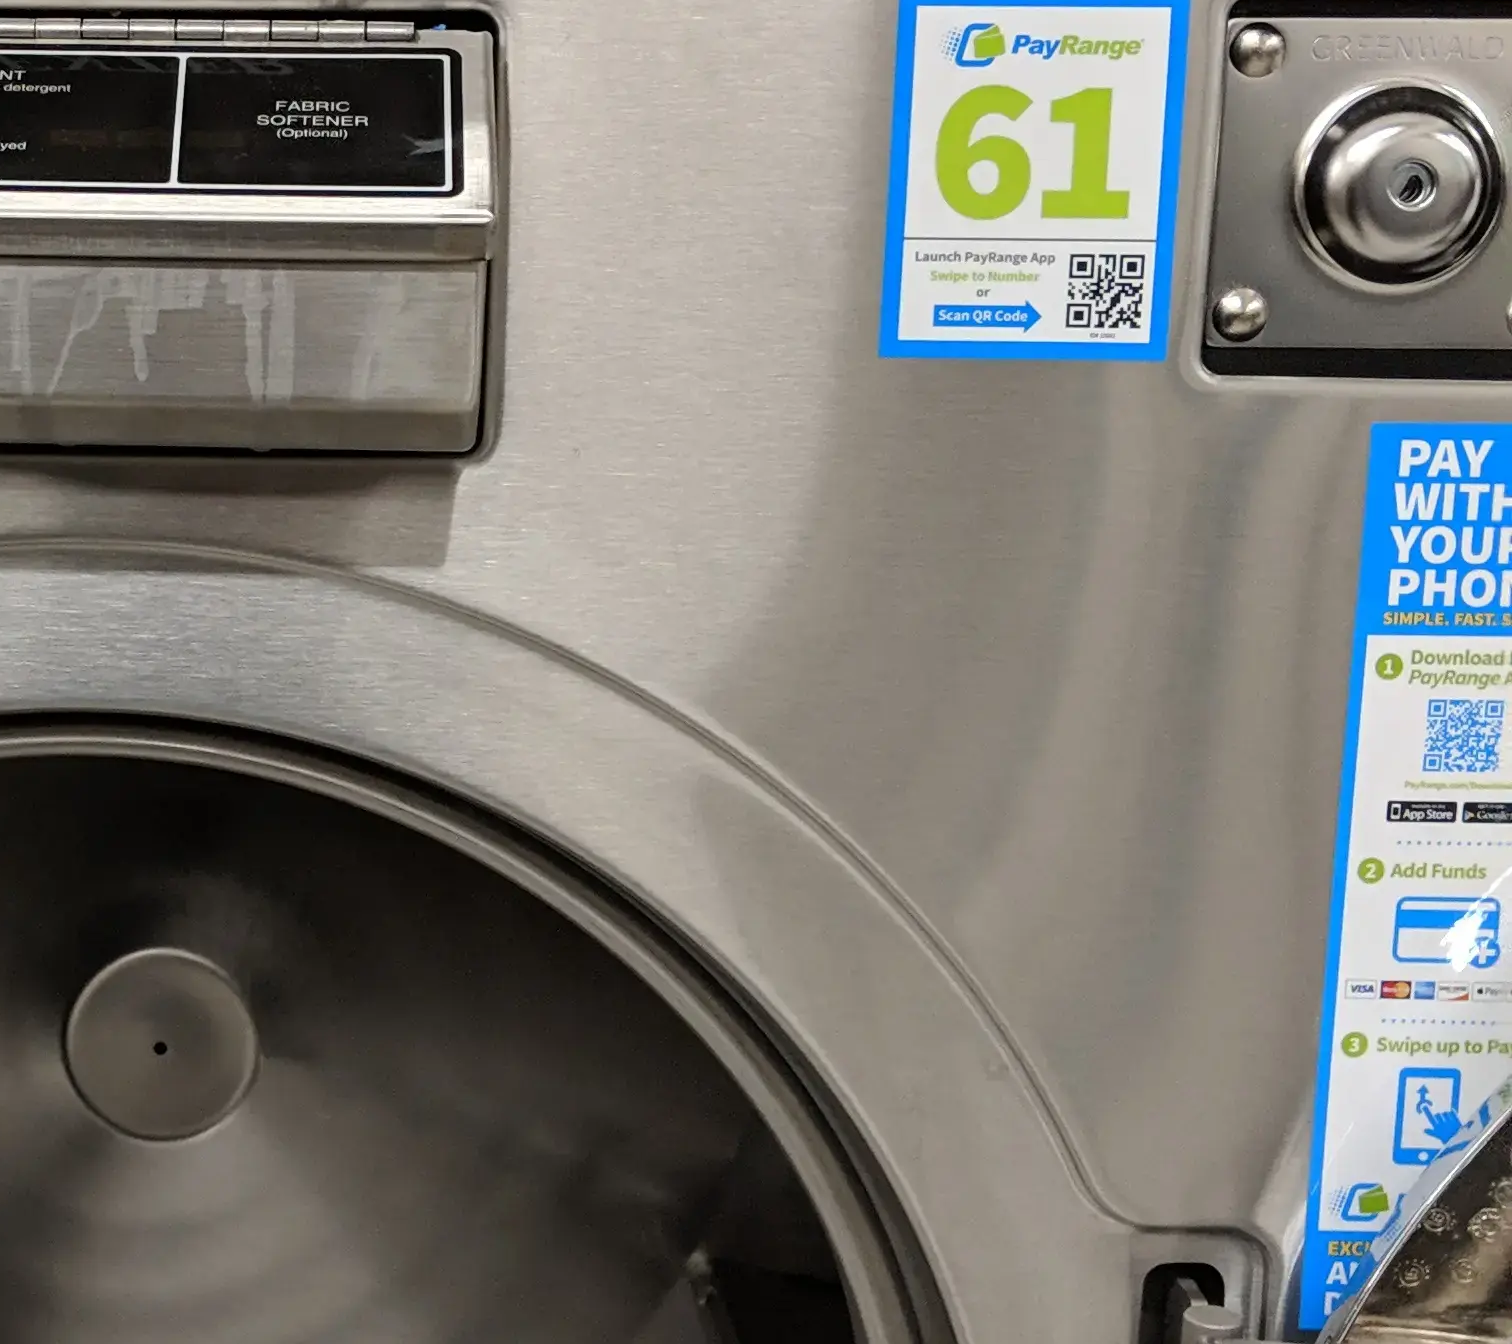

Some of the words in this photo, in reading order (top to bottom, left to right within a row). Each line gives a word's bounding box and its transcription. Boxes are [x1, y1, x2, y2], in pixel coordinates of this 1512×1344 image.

[1011, 34, 1144, 59] PayRange
[1310, 34, 1505, 62] GREENWALD
[4, 83, 71, 94] detergent
[276, 101, 350, 112] FABRIC
[257, 115, 368, 126] SOFTENER
[276, 128, 348, 140] (Optional)
[935, 84, 1130, 220] 61
[915, 251, 961, 263] Launch
[965, 252, 1028, 265] PayRange
[1031, 253, 1055, 265] App
[931, 270, 969, 283] Swipe
[972, 272, 985, 282] to
[988, 271, 1039, 283] Number
[976, 288, 990, 297] or
[938, 310, 969, 322] Scan
[973, 310, 991, 322] QR
[995, 311, 1028, 322] Code
[1398, 439, 1494, 477] PAY
[1383, 612, 1449, 626] SIMPLE.
[1455, 613, 1497, 626] FAST.
[1411, 650, 1505, 665] Download
[1408, 670, 1500, 689] PayRange
[1391, 864, 1427, 878] Add
[1432, 864, 1486, 879] Funds
[1377, 1037, 1432, 1056] Swipe
[1437, 1041, 1460, 1056] up
[1465, 1039, 1482, 1054] to
